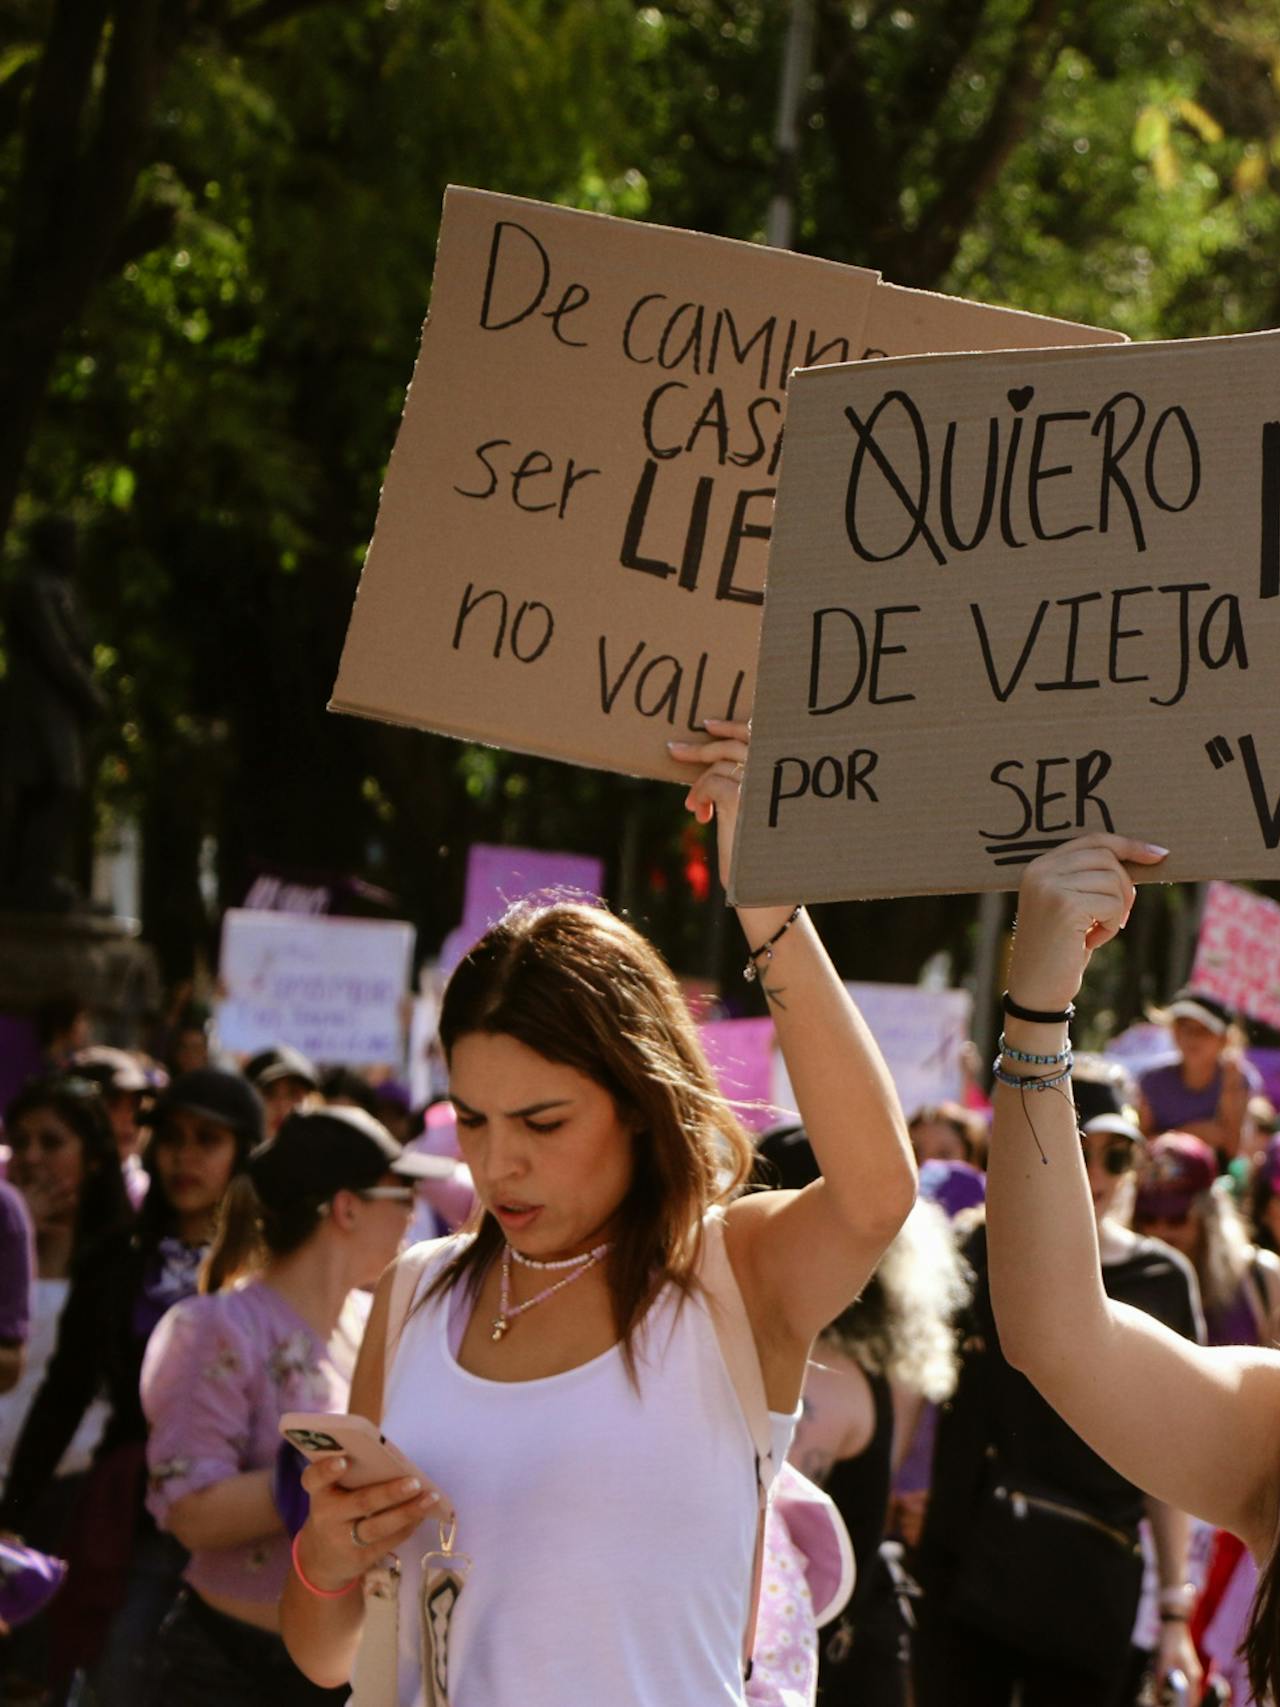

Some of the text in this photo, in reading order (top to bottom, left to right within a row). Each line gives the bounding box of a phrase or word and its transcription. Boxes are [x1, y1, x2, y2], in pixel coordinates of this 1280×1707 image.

[480, 221, 588, 346] De
[453, 439, 601, 519] ser
[453, 583, 554, 663] no
[808, 604, 921, 716] DE
[978, 748, 1116, 841] SER
